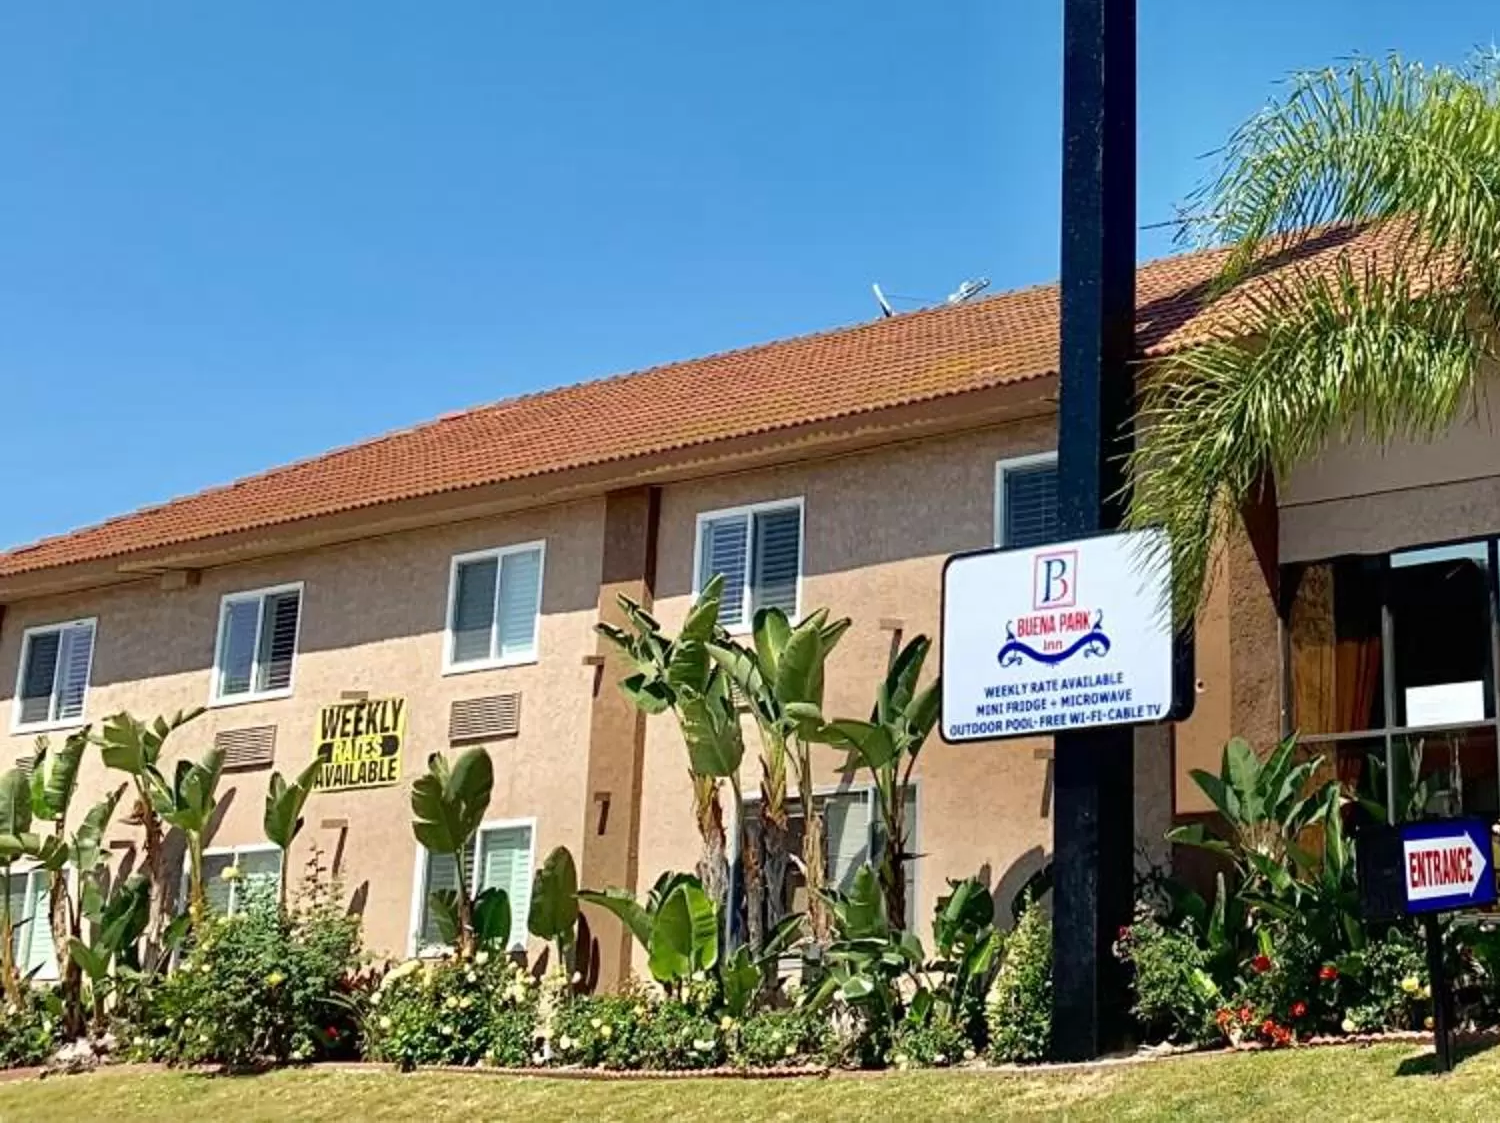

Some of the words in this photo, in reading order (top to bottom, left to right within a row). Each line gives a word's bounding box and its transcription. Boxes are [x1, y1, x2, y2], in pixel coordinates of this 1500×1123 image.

[1016, 614, 1056, 638] BUENA
[1059, 610, 1091, 633] PARK
[984, 682, 1028, 699] WEEKLY
[1030, 678, 1058, 694] RATE
[1061, 671, 1125, 690] AVAILABLE
[976, 702, 1004, 717] MINI
[1005, 698, 1047, 714] FRIDGE
[1061, 688, 1133, 708] MICROWAVE
[321, 698, 404, 740] WEEKLY
[949, 720, 1003, 737] OUTDOOR
[1146, 703, 1162, 716] TV
[332, 735, 383, 765] RATES
[1408, 846, 1474, 889] ENTRANCE
